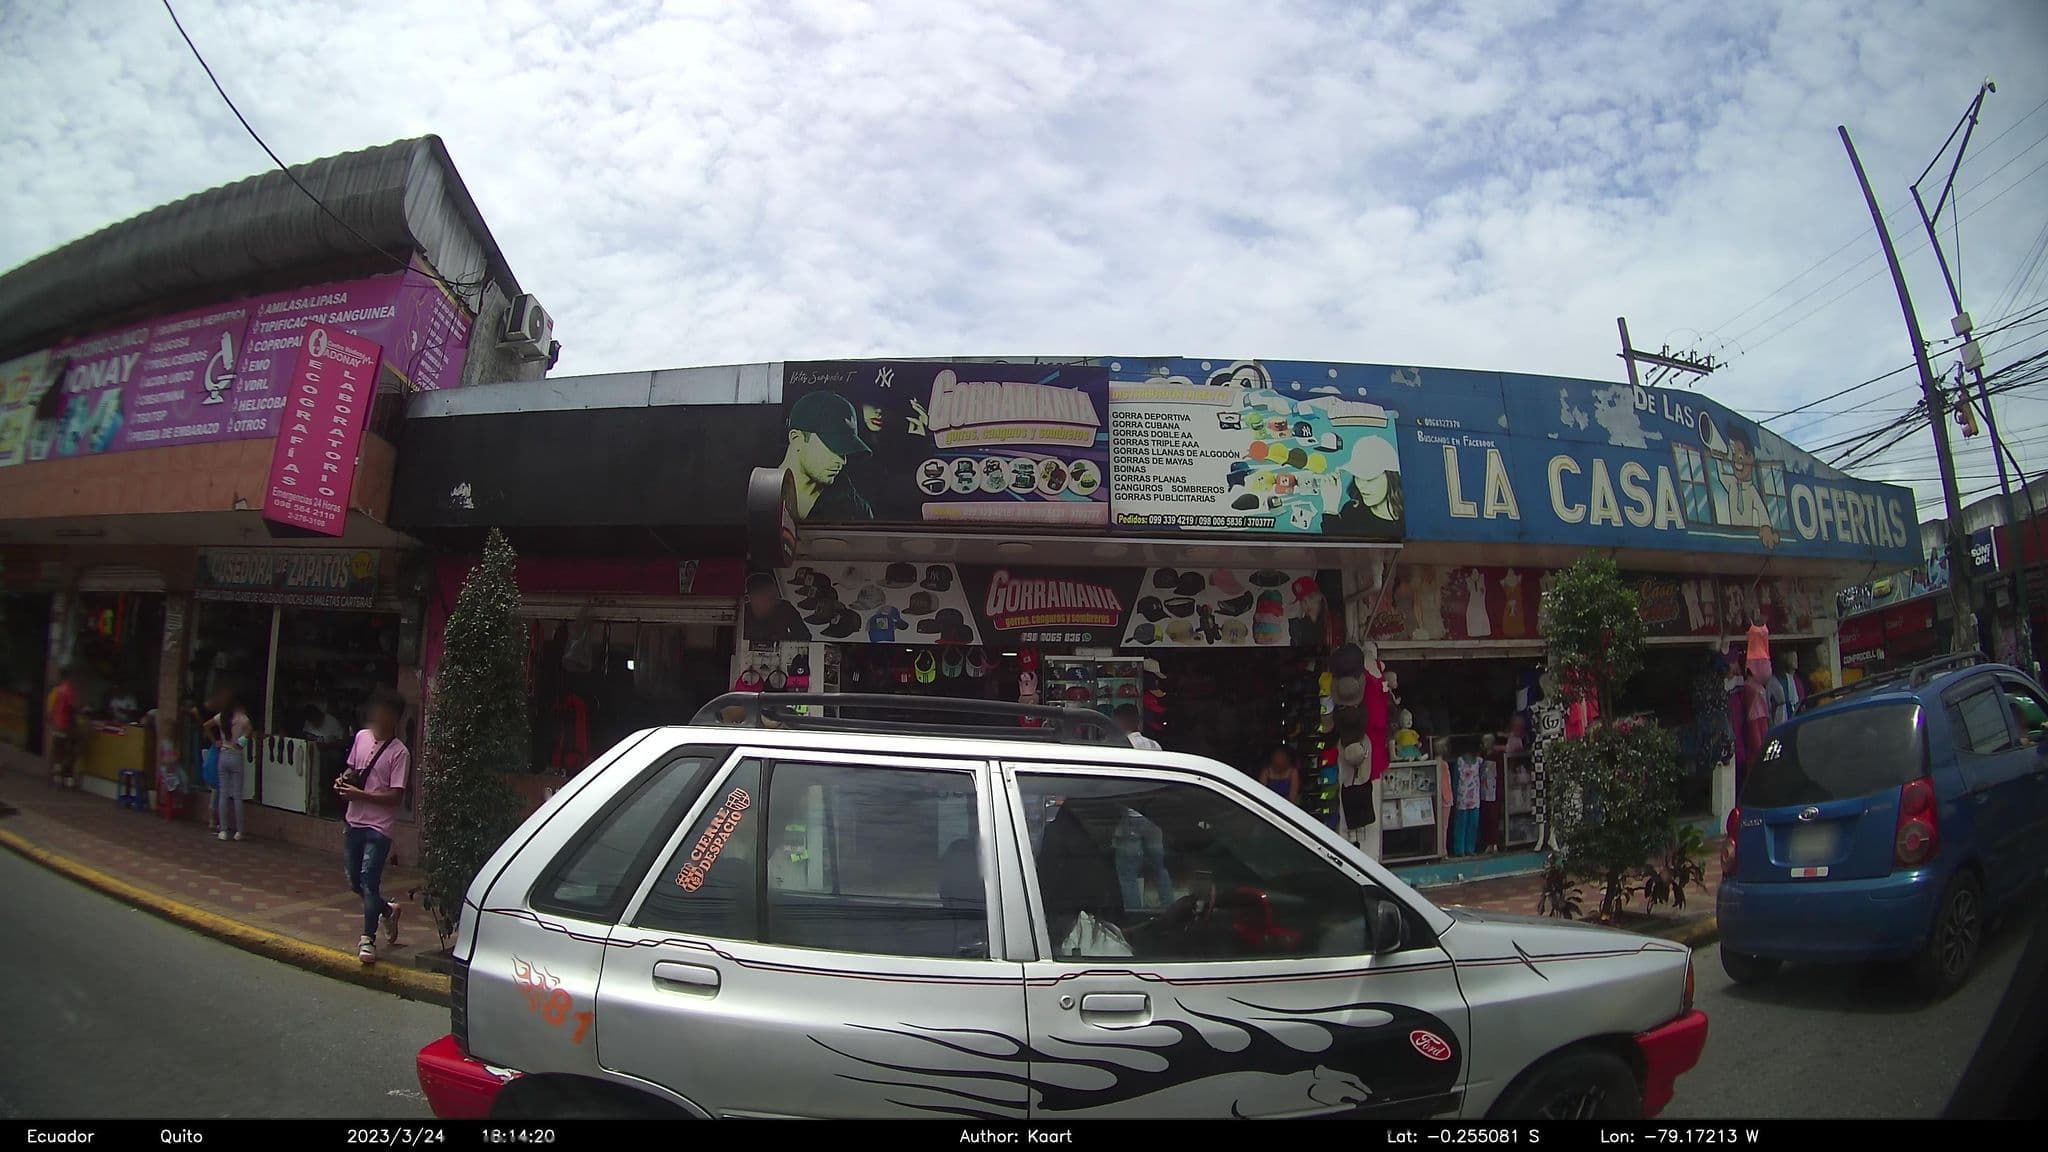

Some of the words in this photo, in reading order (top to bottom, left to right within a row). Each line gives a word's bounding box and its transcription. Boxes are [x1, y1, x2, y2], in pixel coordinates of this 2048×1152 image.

[329, 306, 395, 324] SANGUINEA
[323, 350, 361, 367] ADONAY
[248, 359, 270, 372] EMO
[244, 379, 268, 391] VDRL
[1112, 411, 1143, 420] GORRA
[1144, 413, 1191, 421] DEPORTIVA
[234, 419, 267, 432] OTROS
[1112, 420, 1143, 429] GORRA
[1145, 421, 1180, 430] CUBANA
[318, 370, 356, 496] LABORATORIO
[1113, 429, 1149, 438] GORRAS
[1151, 430, 1180, 439] DOBLE
[1113, 438, 1149, 447] GORRAS
[1151, 439, 1180, 448] TRIPLE
[1182, 441, 1200, 449] AAA
[1113, 447, 1150, 456] GORRAS
[1151, 448, 1184, 457] LLANAS
[1113, 456, 1150, 465] GORRAS
[1152, 457, 1164, 465] DE
[1165, 458, 1194, 466] MAYAS
[1114, 465, 1146, 474] BOINAS
[1114, 474, 1151, 483] GORRAS
[1152, 475, 1187, 484] PLANAS
[1442, 445, 1520, 520] LA
[1114, 483, 1163, 493] CANGUROS
[1171, 484, 1225, 495] SOMBREROS
[1547, 454, 1686, 530] CASA
[1114, 492, 1151, 502] GORRAS
[1153, 493, 1216, 503] PUBLICITARIAS
[322, 500, 341, 513] Horas
[1118, 514, 1148, 525] Pedidos:
[1177, 516, 1194, 526] 4219
[1790, 483, 1908, 548] OFERTAS
[287, 555, 350, 588] ZAPATOS
[986, 570, 1122, 616] GORRAMANIA
[691, 807, 730, 861] CIERRE
[699, 811, 742, 871] DESPACIO
[1416, 1034, 1446, 1056] Ford
